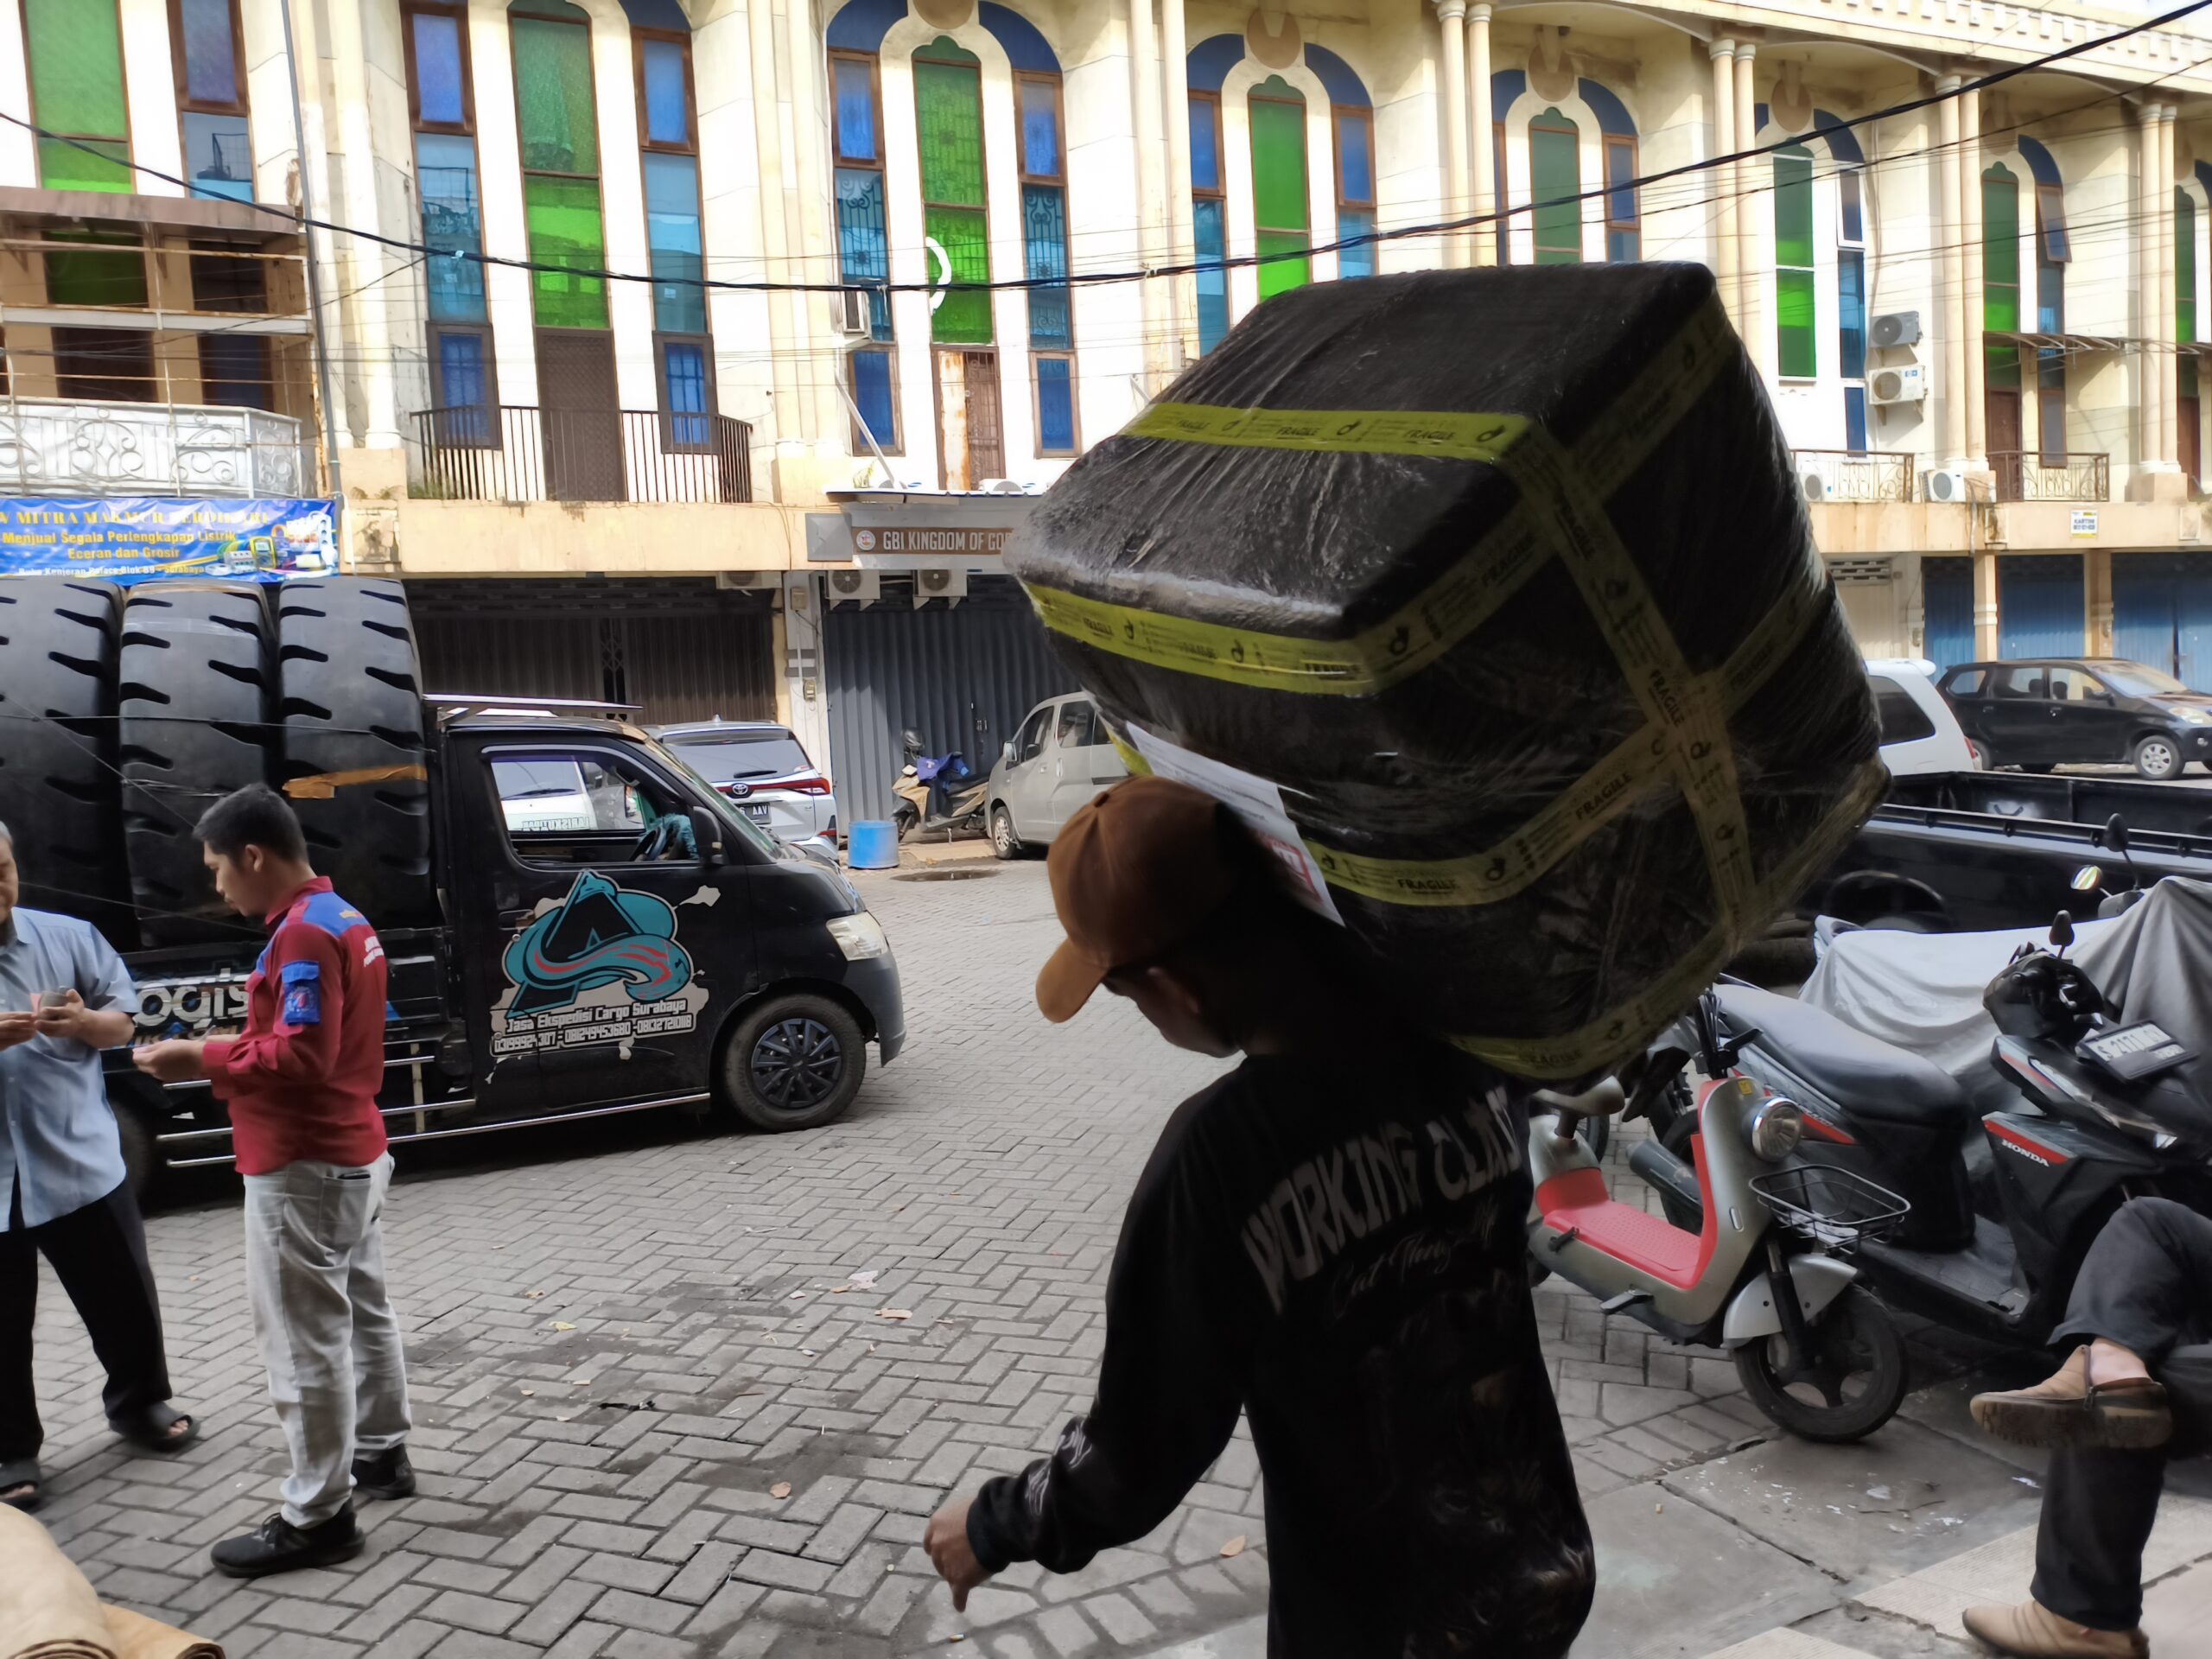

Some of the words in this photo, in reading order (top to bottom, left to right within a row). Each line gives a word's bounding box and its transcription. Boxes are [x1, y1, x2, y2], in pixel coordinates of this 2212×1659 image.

[16, 512, 79, 524] MITRA
[3, 532, 55, 546] Menjual
[61, 531, 104, 545] Segala
[107, 531, 194, 544] Perlengkapan
[198, 531, 236, 542] Listrik
[882, 531, 905, 551] GBI
[907, 531, 966, 551] KINGDOM
[969, 531, 985, 551] OF
[67, 548, 111, 559] Eceran
[116, 547, 139, 558] dan
[143, 547, 181, 558] Grosir
[1649, 669, 1686, 728] FRAGILE
[1574, 772, 1632, 821] FRAGILE
[1397, 879, 1457, 890] FRAGILE
[506, 1018, 535, 1033] Jasa
[537, 1008, 593, 1030] Ekspedisi
[595, 1005, 630, 1022] Cargo
[632, 999, 687, 1017] Surabaya
[2001, 1138, 2049, 1166] HONDA
[1241, 1120, 1422, 1316] WORKING
